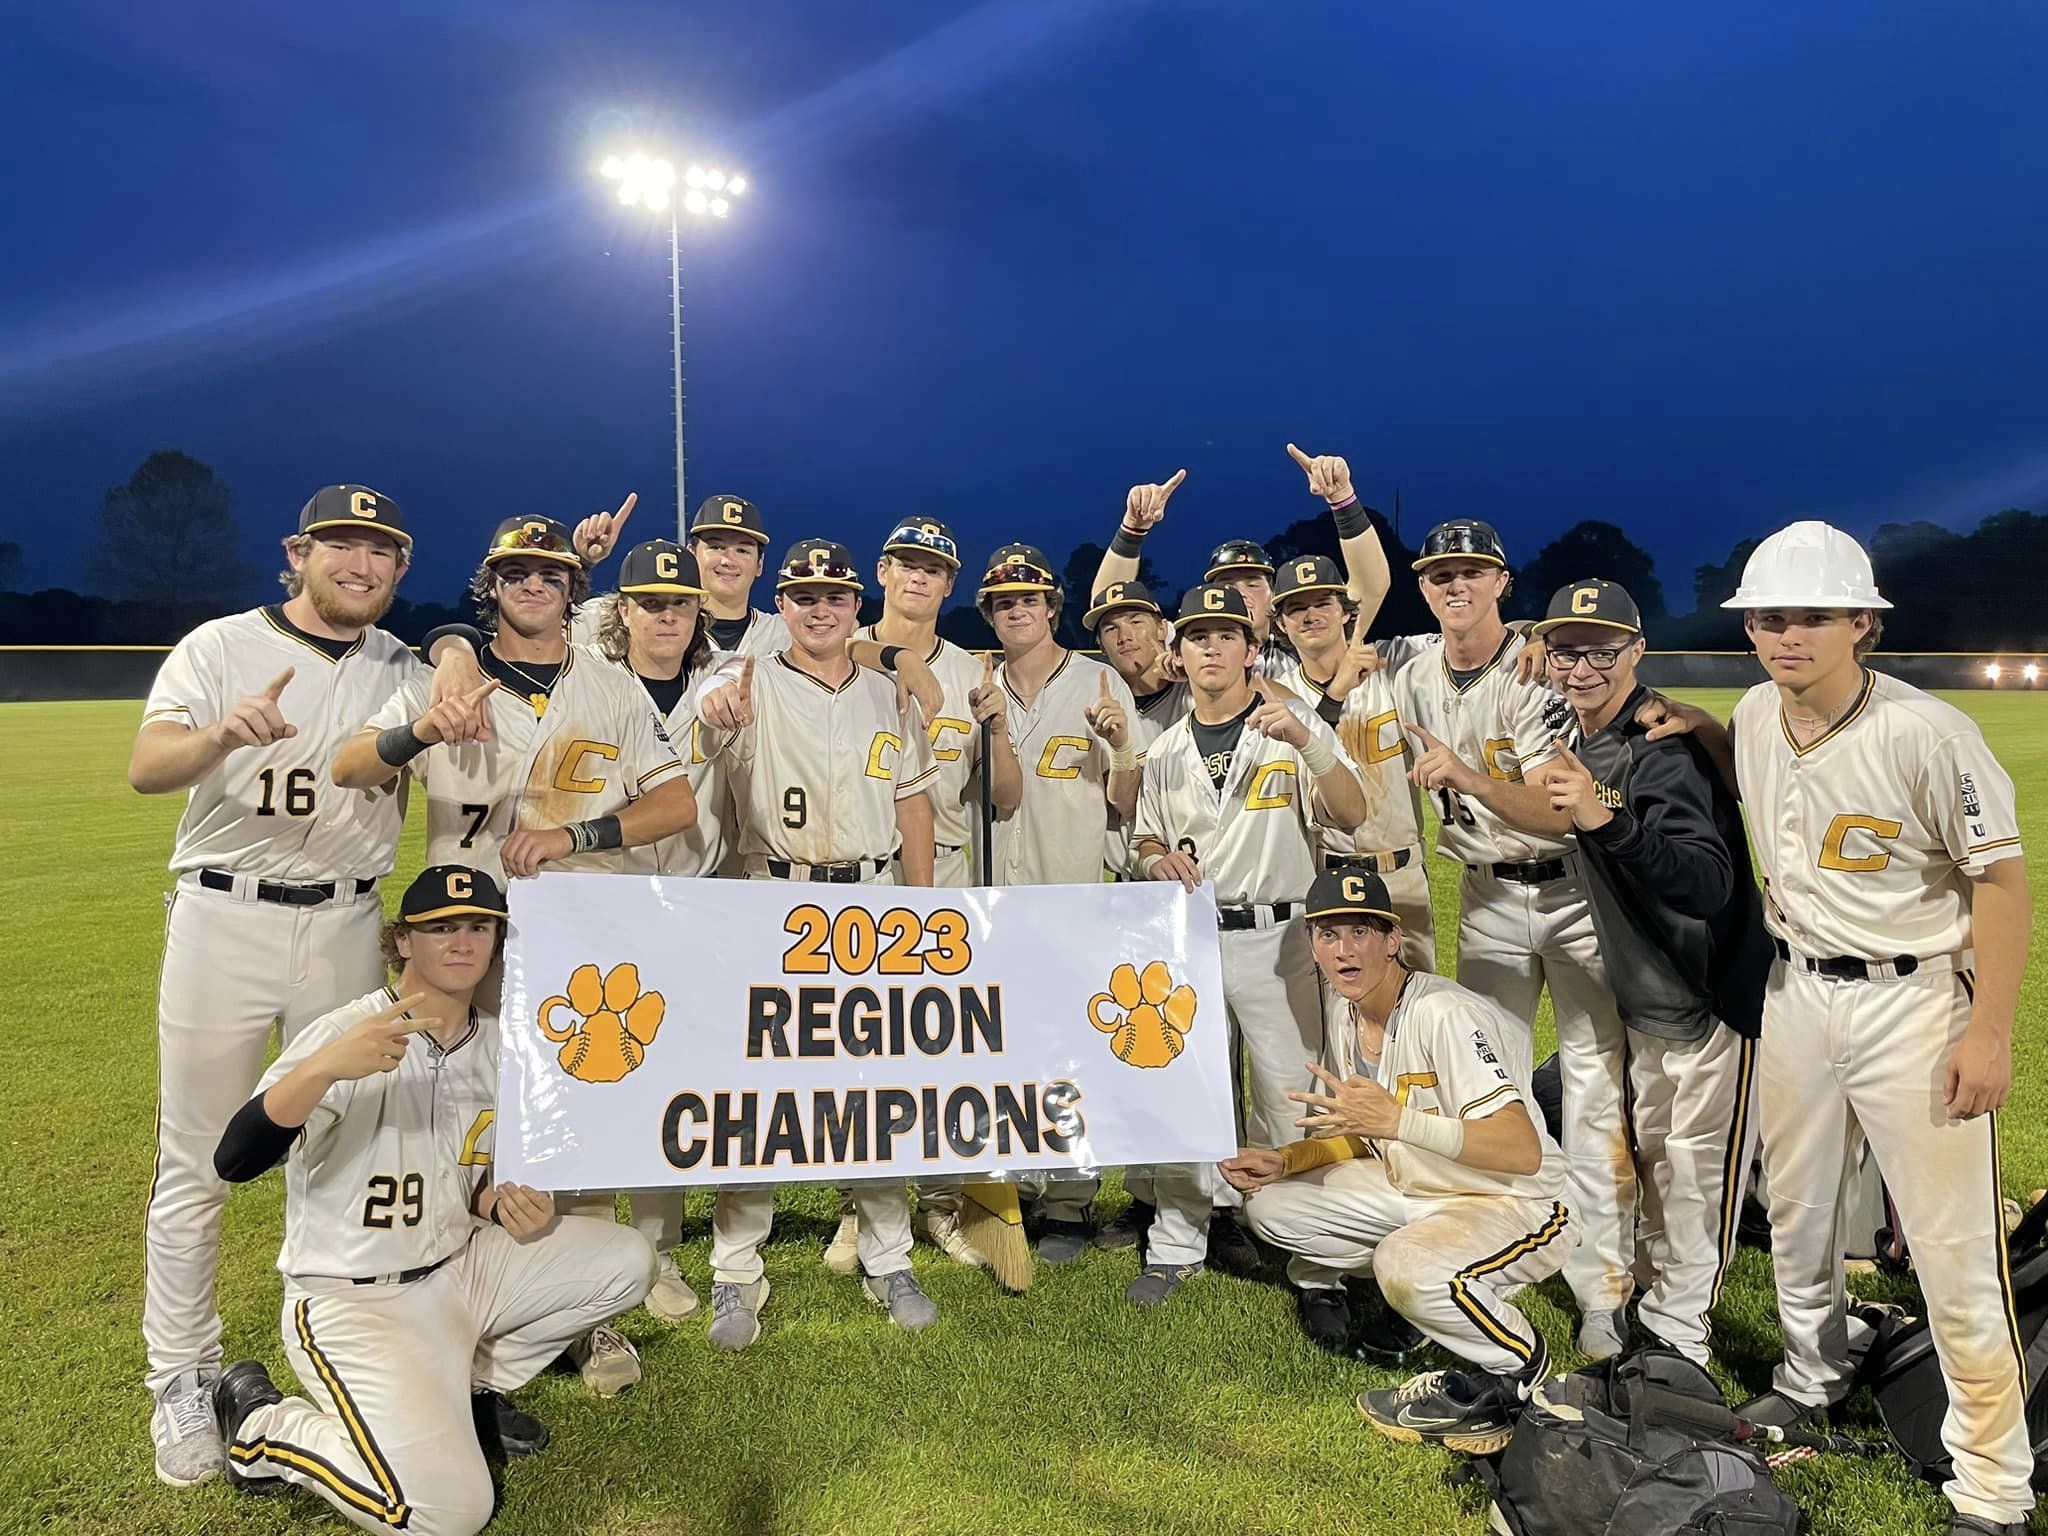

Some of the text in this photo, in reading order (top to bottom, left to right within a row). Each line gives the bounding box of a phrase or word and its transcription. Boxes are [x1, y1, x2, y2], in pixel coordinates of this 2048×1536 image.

[351, 492, 377, 519] C
[723, 502, 742, 523] C
[523, 521, 547, 542] C
[656, 553, 678, 578] C
[1296, 563, 1315, 585] C
[1107, 585, 1124, 602] C
[1204, 589, 1224, 610] C
[1572, 588, 1598, 613] C
[927, 717, 972, 761] C
[1036, 736, 1092, 779] C
[1365, 709, 1408, 764] C
[553, 740, 618, 793] C
[1246, 760, 1296, 811] C
[257, 768, 315, 816] 16
[783, 786, 807, 828] 9
[460, 804, 490, 849] 7
[1818, 814, 1902, 872] C
[447, 873, 472, 898] C
[1342, 876, 1366, 902] C
[783, 903, 972, 975] 2023
[745, 983, 1004, 1060] REGION
[661, 1079, 1087, 1170] CHAMPIONS
[363, 1173, 423, 1230] 29
